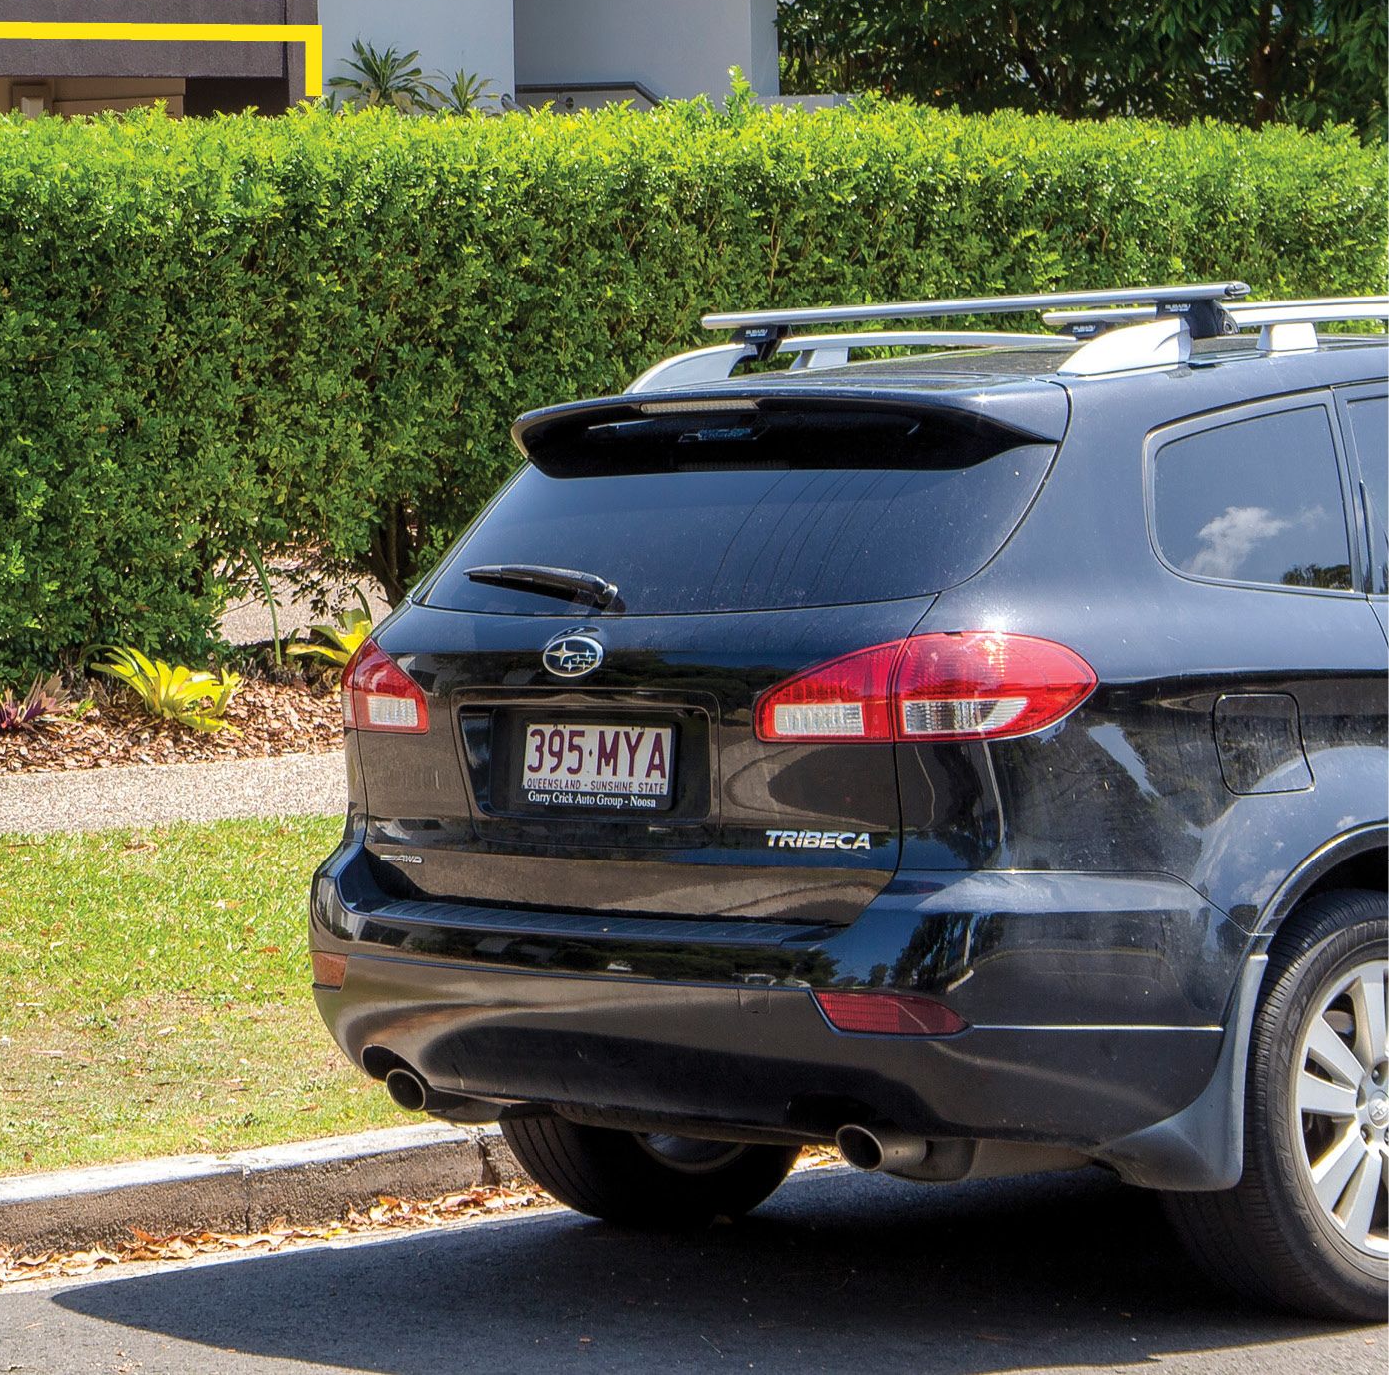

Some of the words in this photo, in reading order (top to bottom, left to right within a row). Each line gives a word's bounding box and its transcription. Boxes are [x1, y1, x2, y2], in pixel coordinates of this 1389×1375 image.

[527, 777, 581, 789] QUEENSLAND
[590, 780, 633, 793] SUNSHINE
[638, 782, 664, 794] STATE
[528, 790, 551, 805] Garry
[552, 791, 573, 803] Crick
[575, 792, 595, 805] Auto
[597, 794, 623, 809] Group
[630, 796, 656, 808] Noosa
[765, 829, 871, 850] TRIBECA
